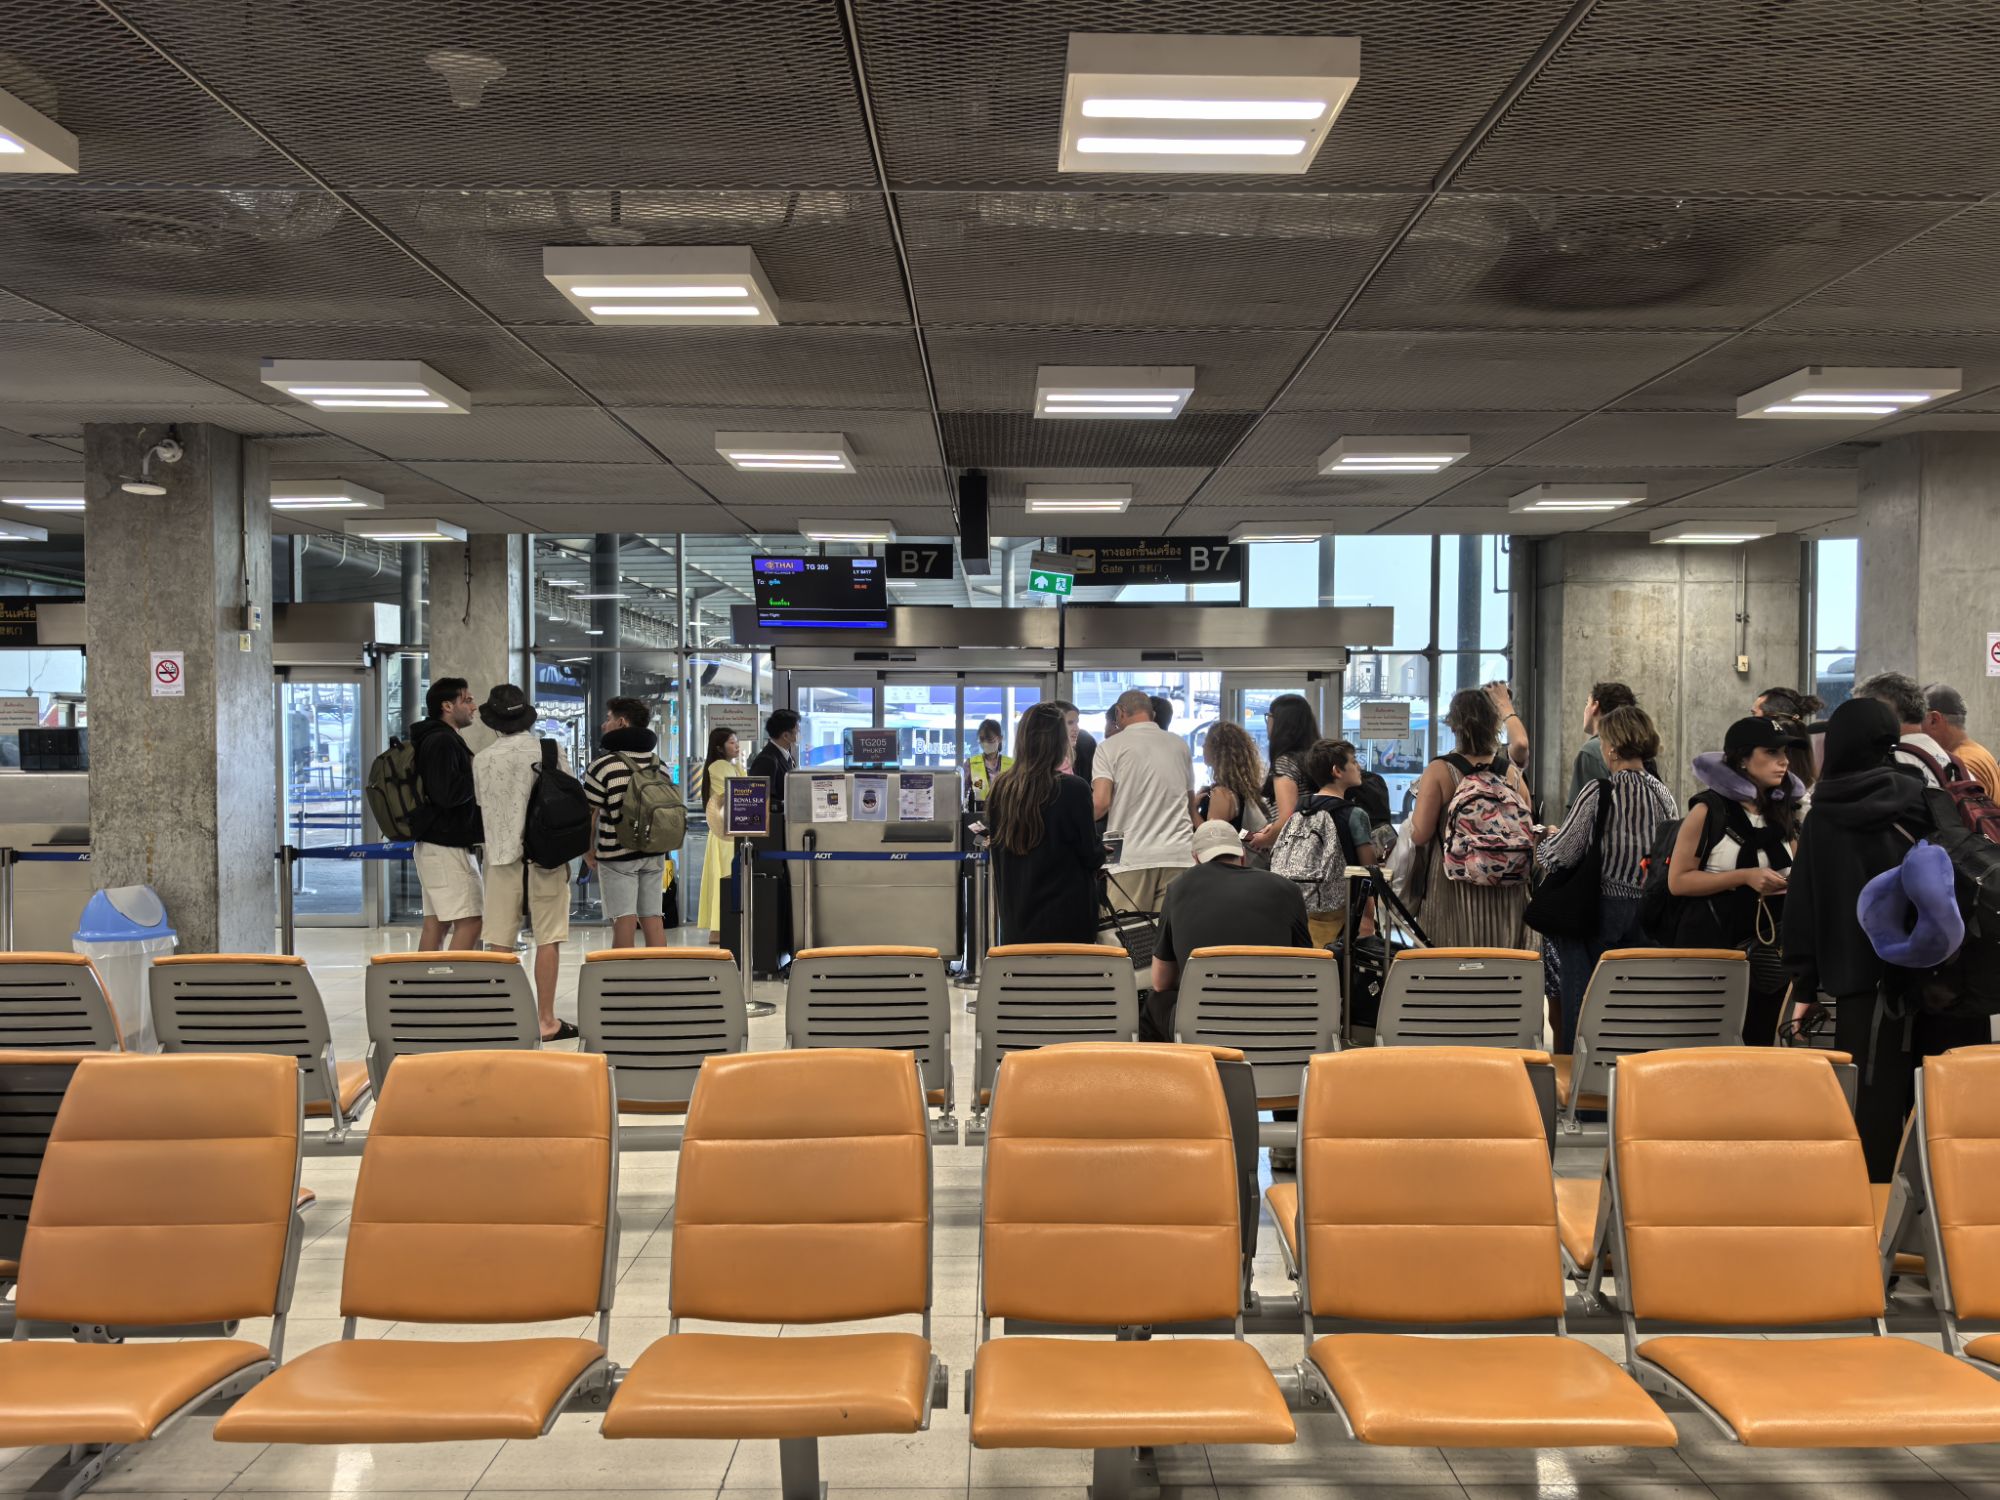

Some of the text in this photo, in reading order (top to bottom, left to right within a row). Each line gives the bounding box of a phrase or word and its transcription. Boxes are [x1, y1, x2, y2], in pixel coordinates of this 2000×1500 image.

[900, 550, 938, 573] B7
[1190, 546, 1231, 572] B7
[775, 561, 794, 569] THAI
[1101, 564, 1124, 574] Gate
[861, 738, 887, 747] TG205
[915, 737, 972, 757] Bangkk
[965, 852, 983, 860] AOT
